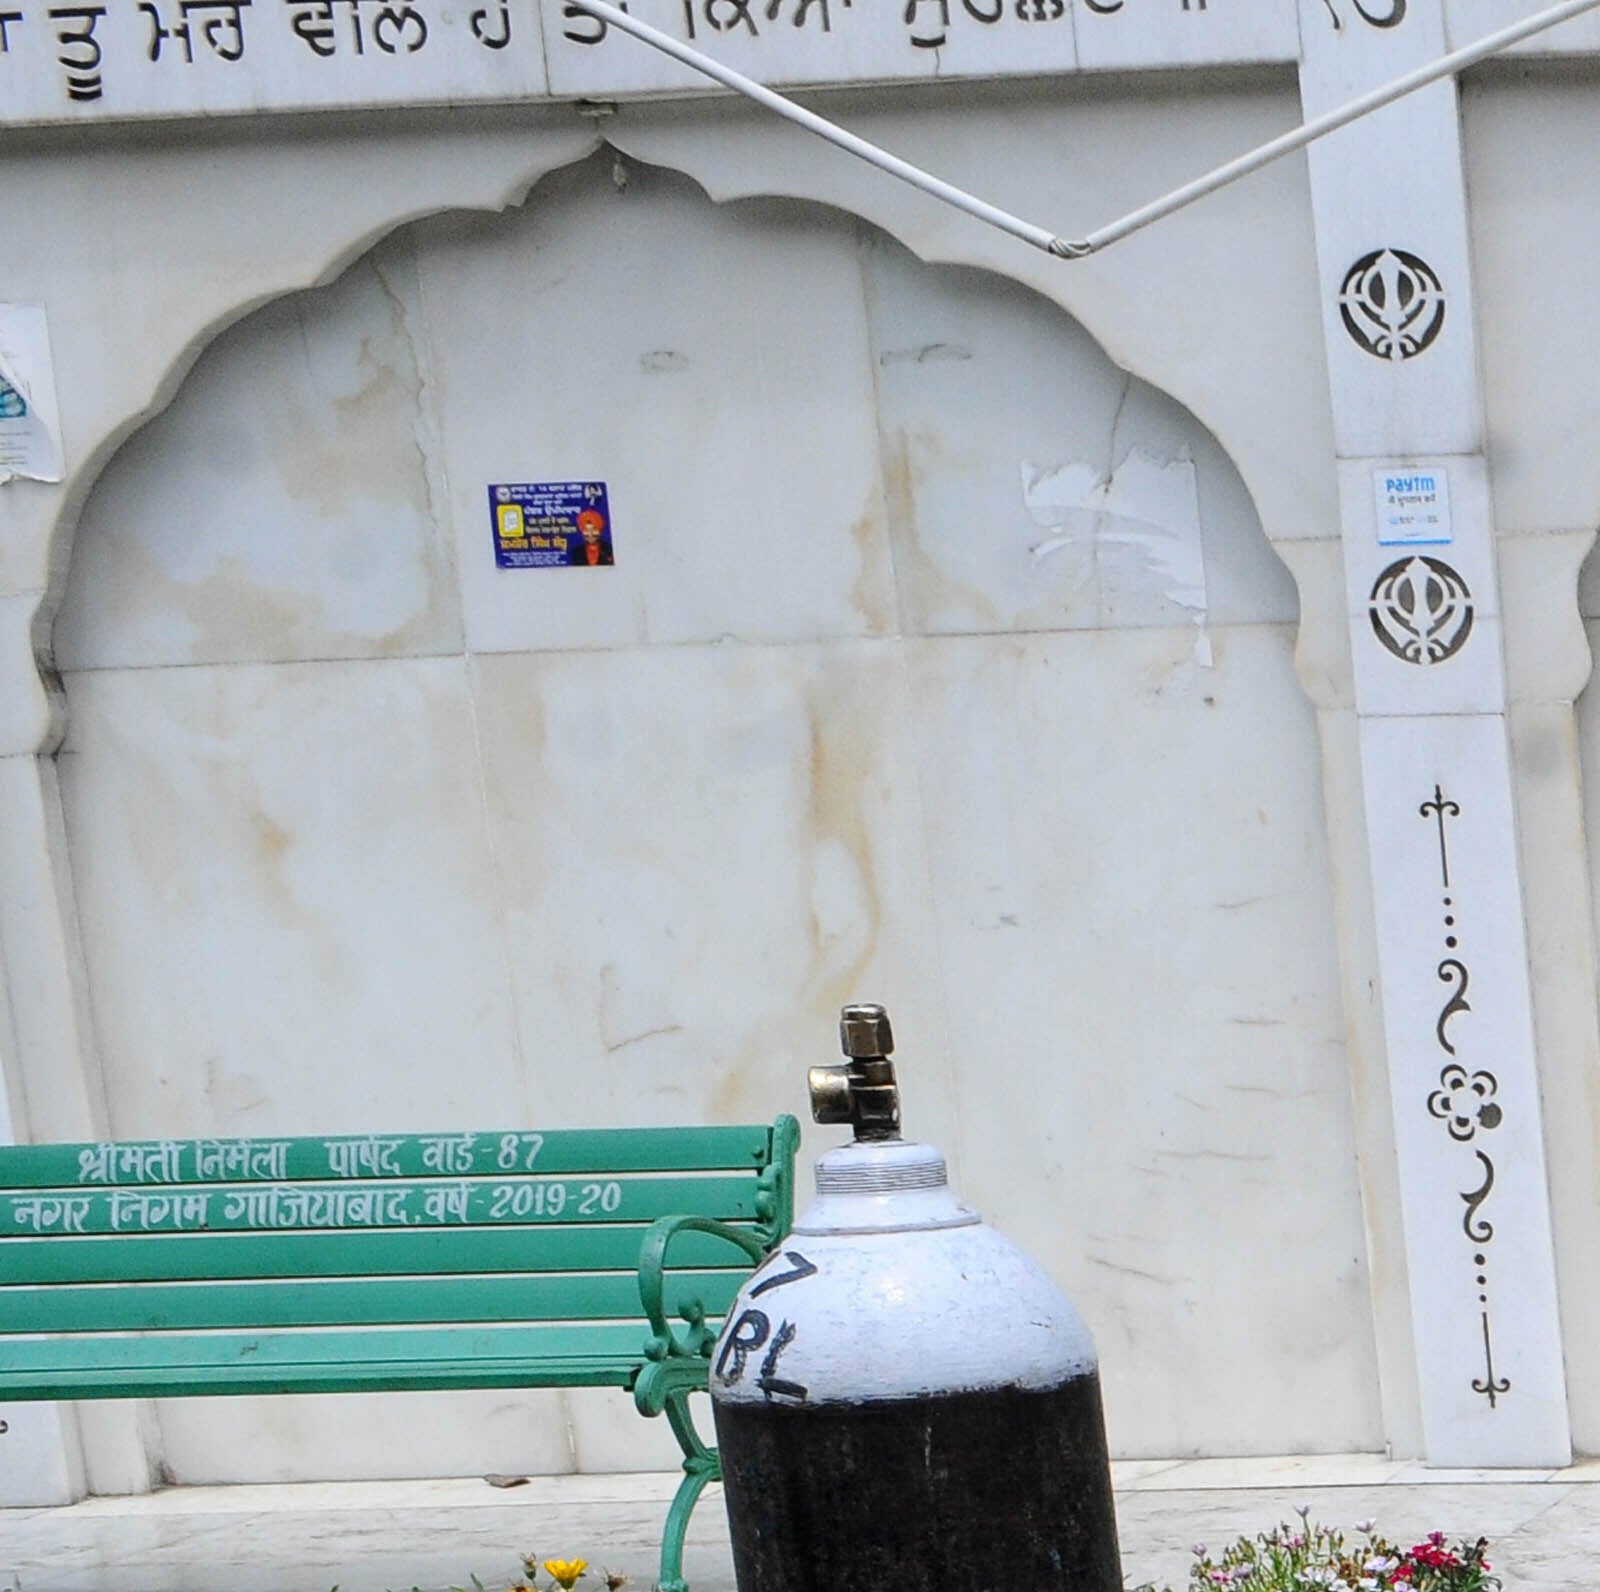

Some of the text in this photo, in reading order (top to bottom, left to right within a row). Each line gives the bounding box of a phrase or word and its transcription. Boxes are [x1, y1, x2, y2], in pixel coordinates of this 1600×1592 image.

[78, 1139, 187, 1184] श्रीमती
[192, 1137, 292, 1181] निर्मला
[324, 1135, 407, 1178] पार्षद
[11, 1196, 94, 1232] नगर
[106, 1190, 214, 1230] निगम
